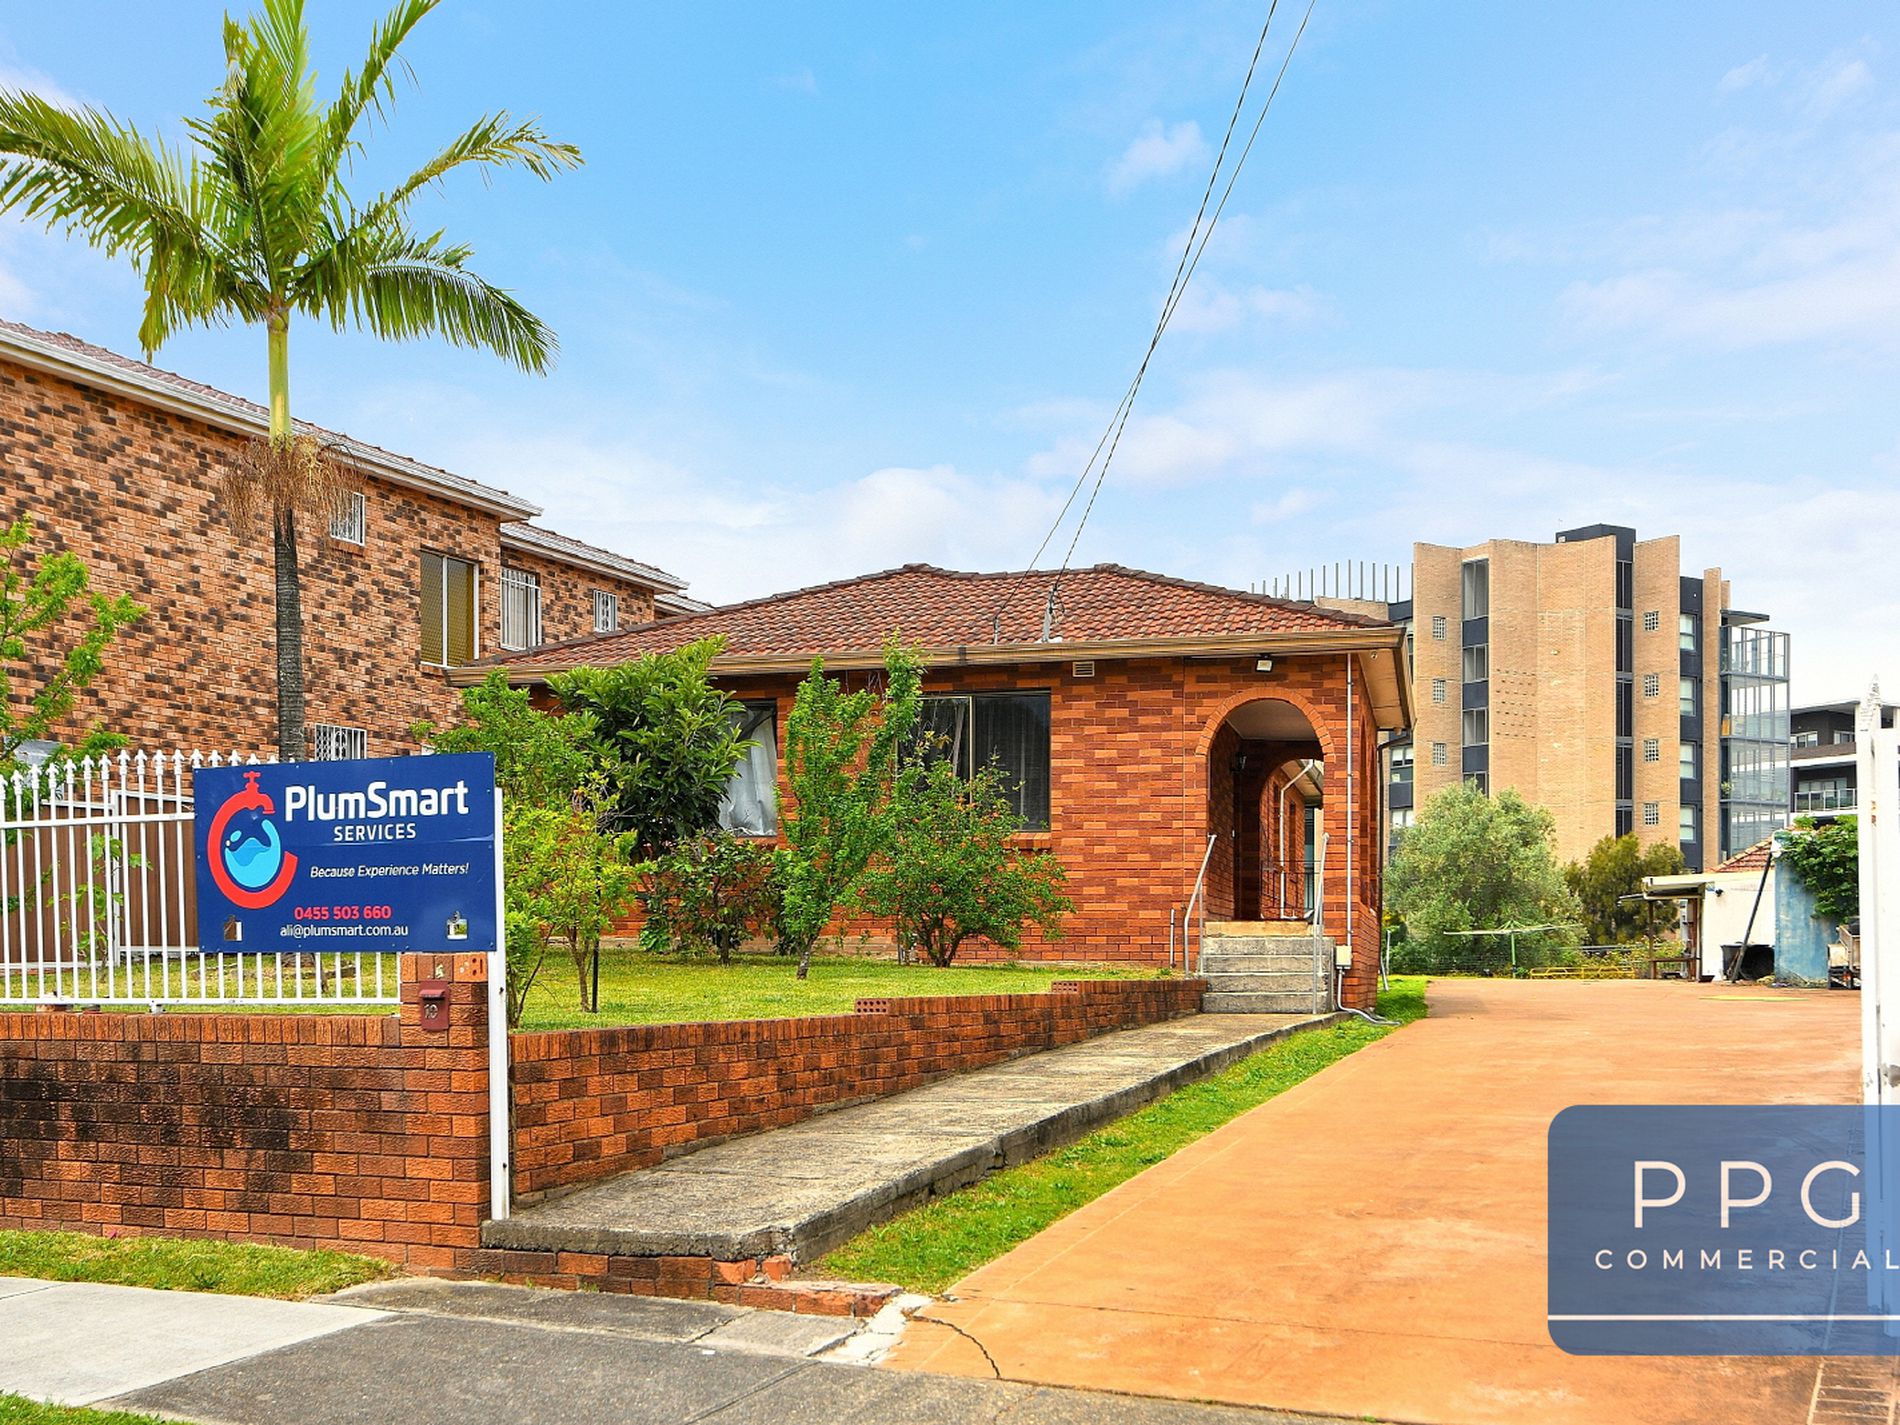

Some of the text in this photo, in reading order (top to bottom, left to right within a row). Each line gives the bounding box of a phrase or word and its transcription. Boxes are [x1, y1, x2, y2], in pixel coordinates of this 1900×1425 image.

[285, 780, 469, 821] PlumSmart
[333, 823, 417, 842] SERVICES
[310, 862, 469, 879] Because Experience Matters!
[294, 905, 392, 920] 0455 503 660
[279, 923, 409, 938] ali@plumsmart.com.au
